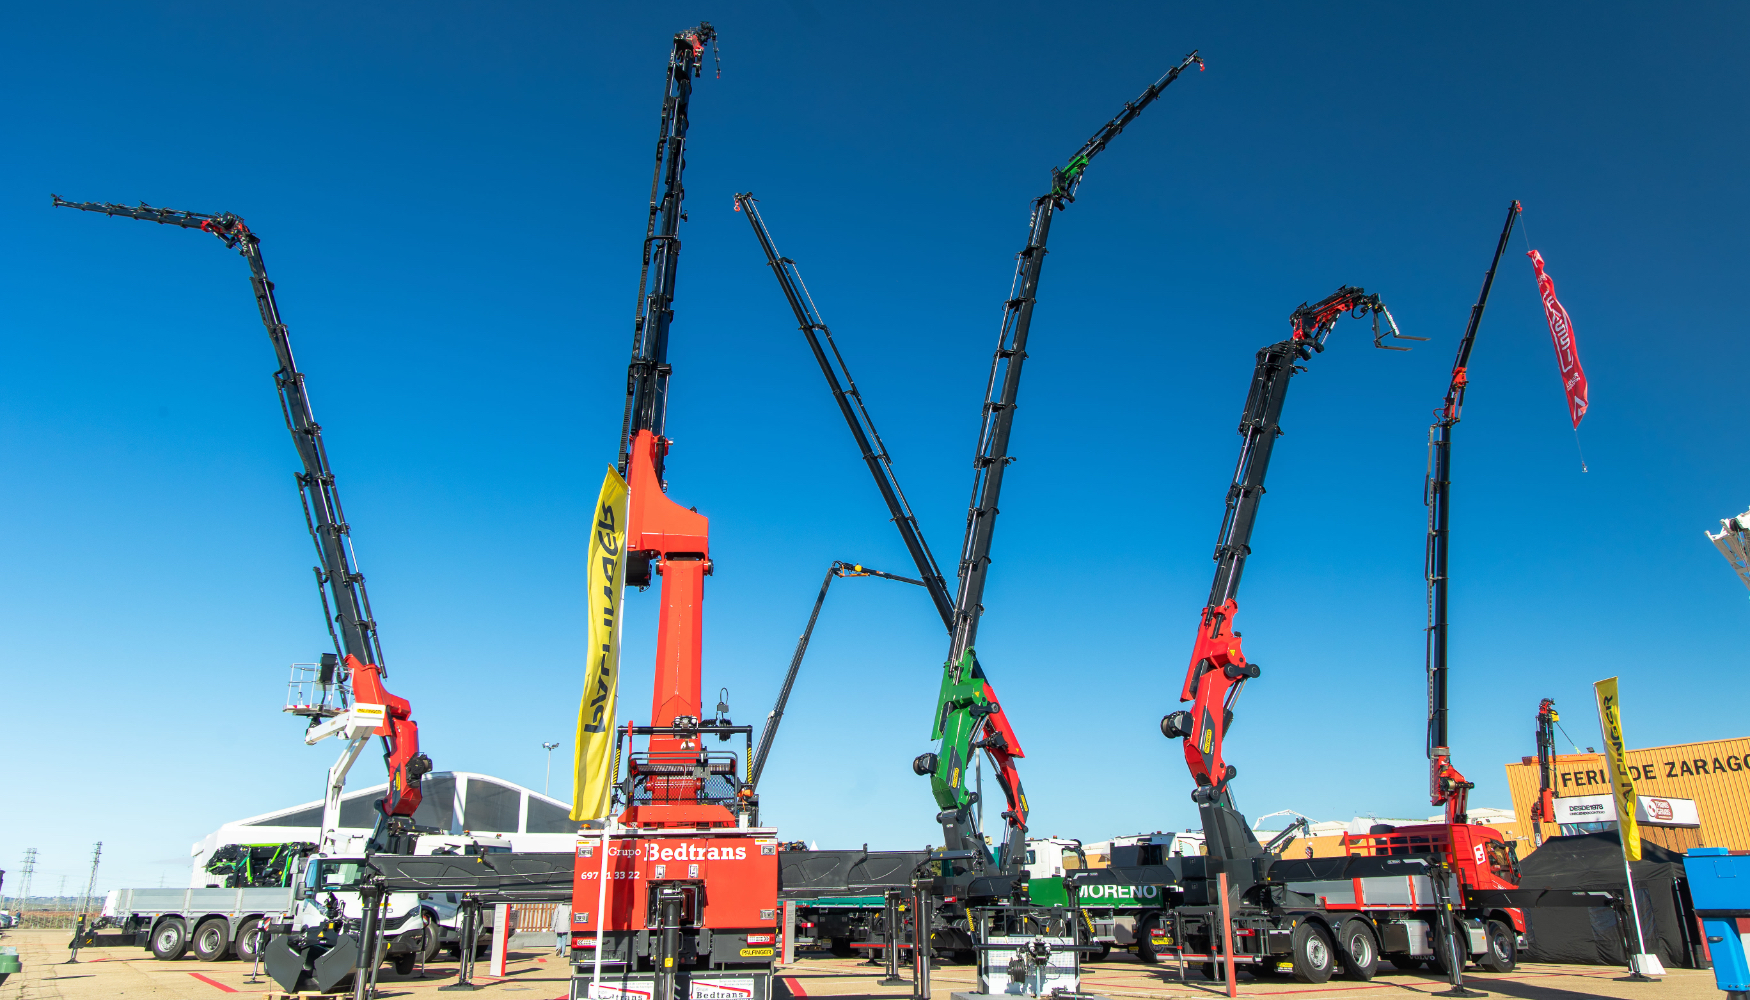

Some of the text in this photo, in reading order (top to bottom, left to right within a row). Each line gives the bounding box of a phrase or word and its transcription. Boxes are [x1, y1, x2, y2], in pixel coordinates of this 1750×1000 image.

[1560, 769, 1612, 787] FERI
[1628, 764, 1657, 781] DE
[608, 842, 747, 861] Grupo Bedtrans
[581, 871, 598, 880] 697
[614, 871, 625, 879] 33
[628, 871, 640, 879] 22
[1079, 884, 1157, 898] MORENO
